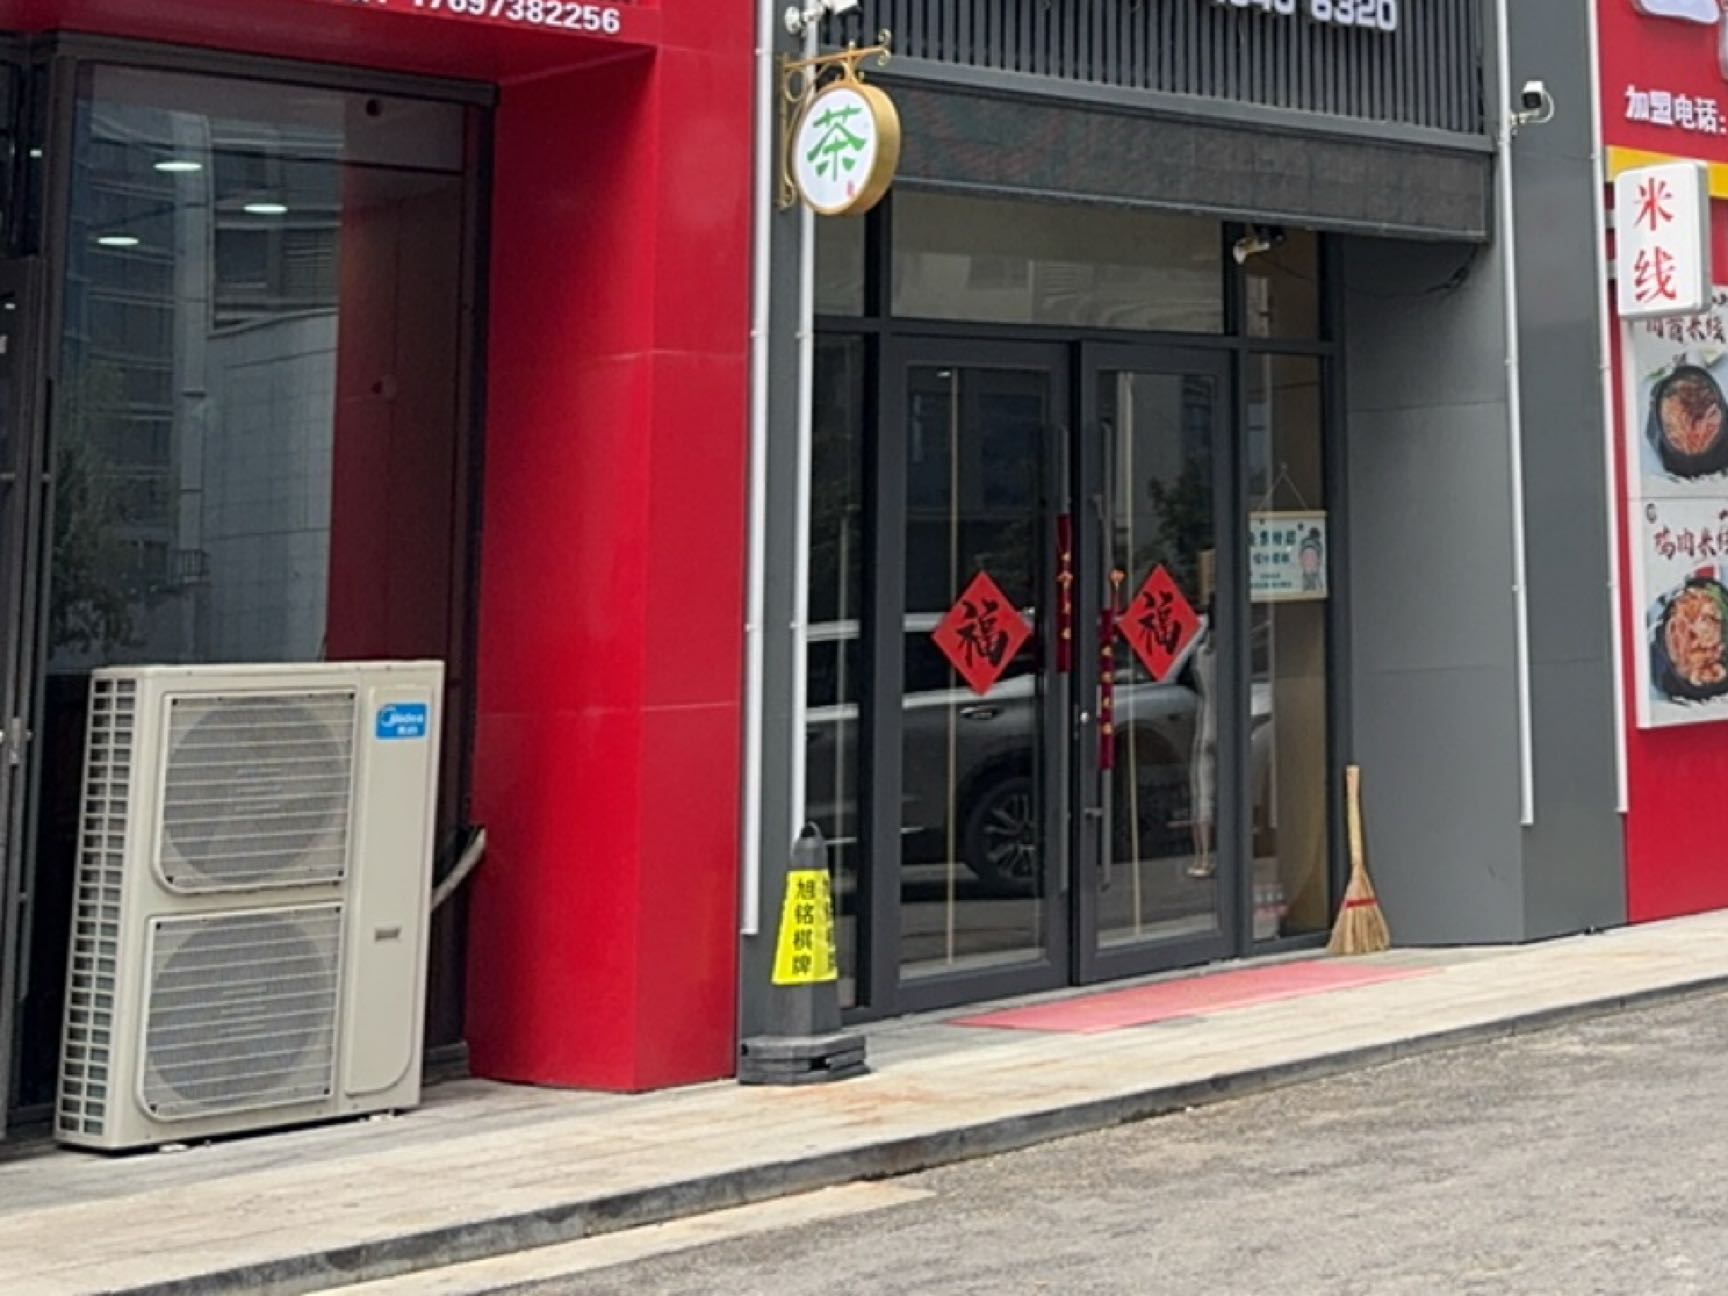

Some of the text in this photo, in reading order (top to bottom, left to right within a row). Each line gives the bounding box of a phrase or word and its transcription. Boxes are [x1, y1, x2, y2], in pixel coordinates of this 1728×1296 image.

[806, 105, 868, 183] 茶
[1633, 177, 1678, 304] 米线
[957, 596, 1008, 669] 福
[1137, 588, 1182, 657] 福
[792, 879, 815, 975] 旭铭棋牌
